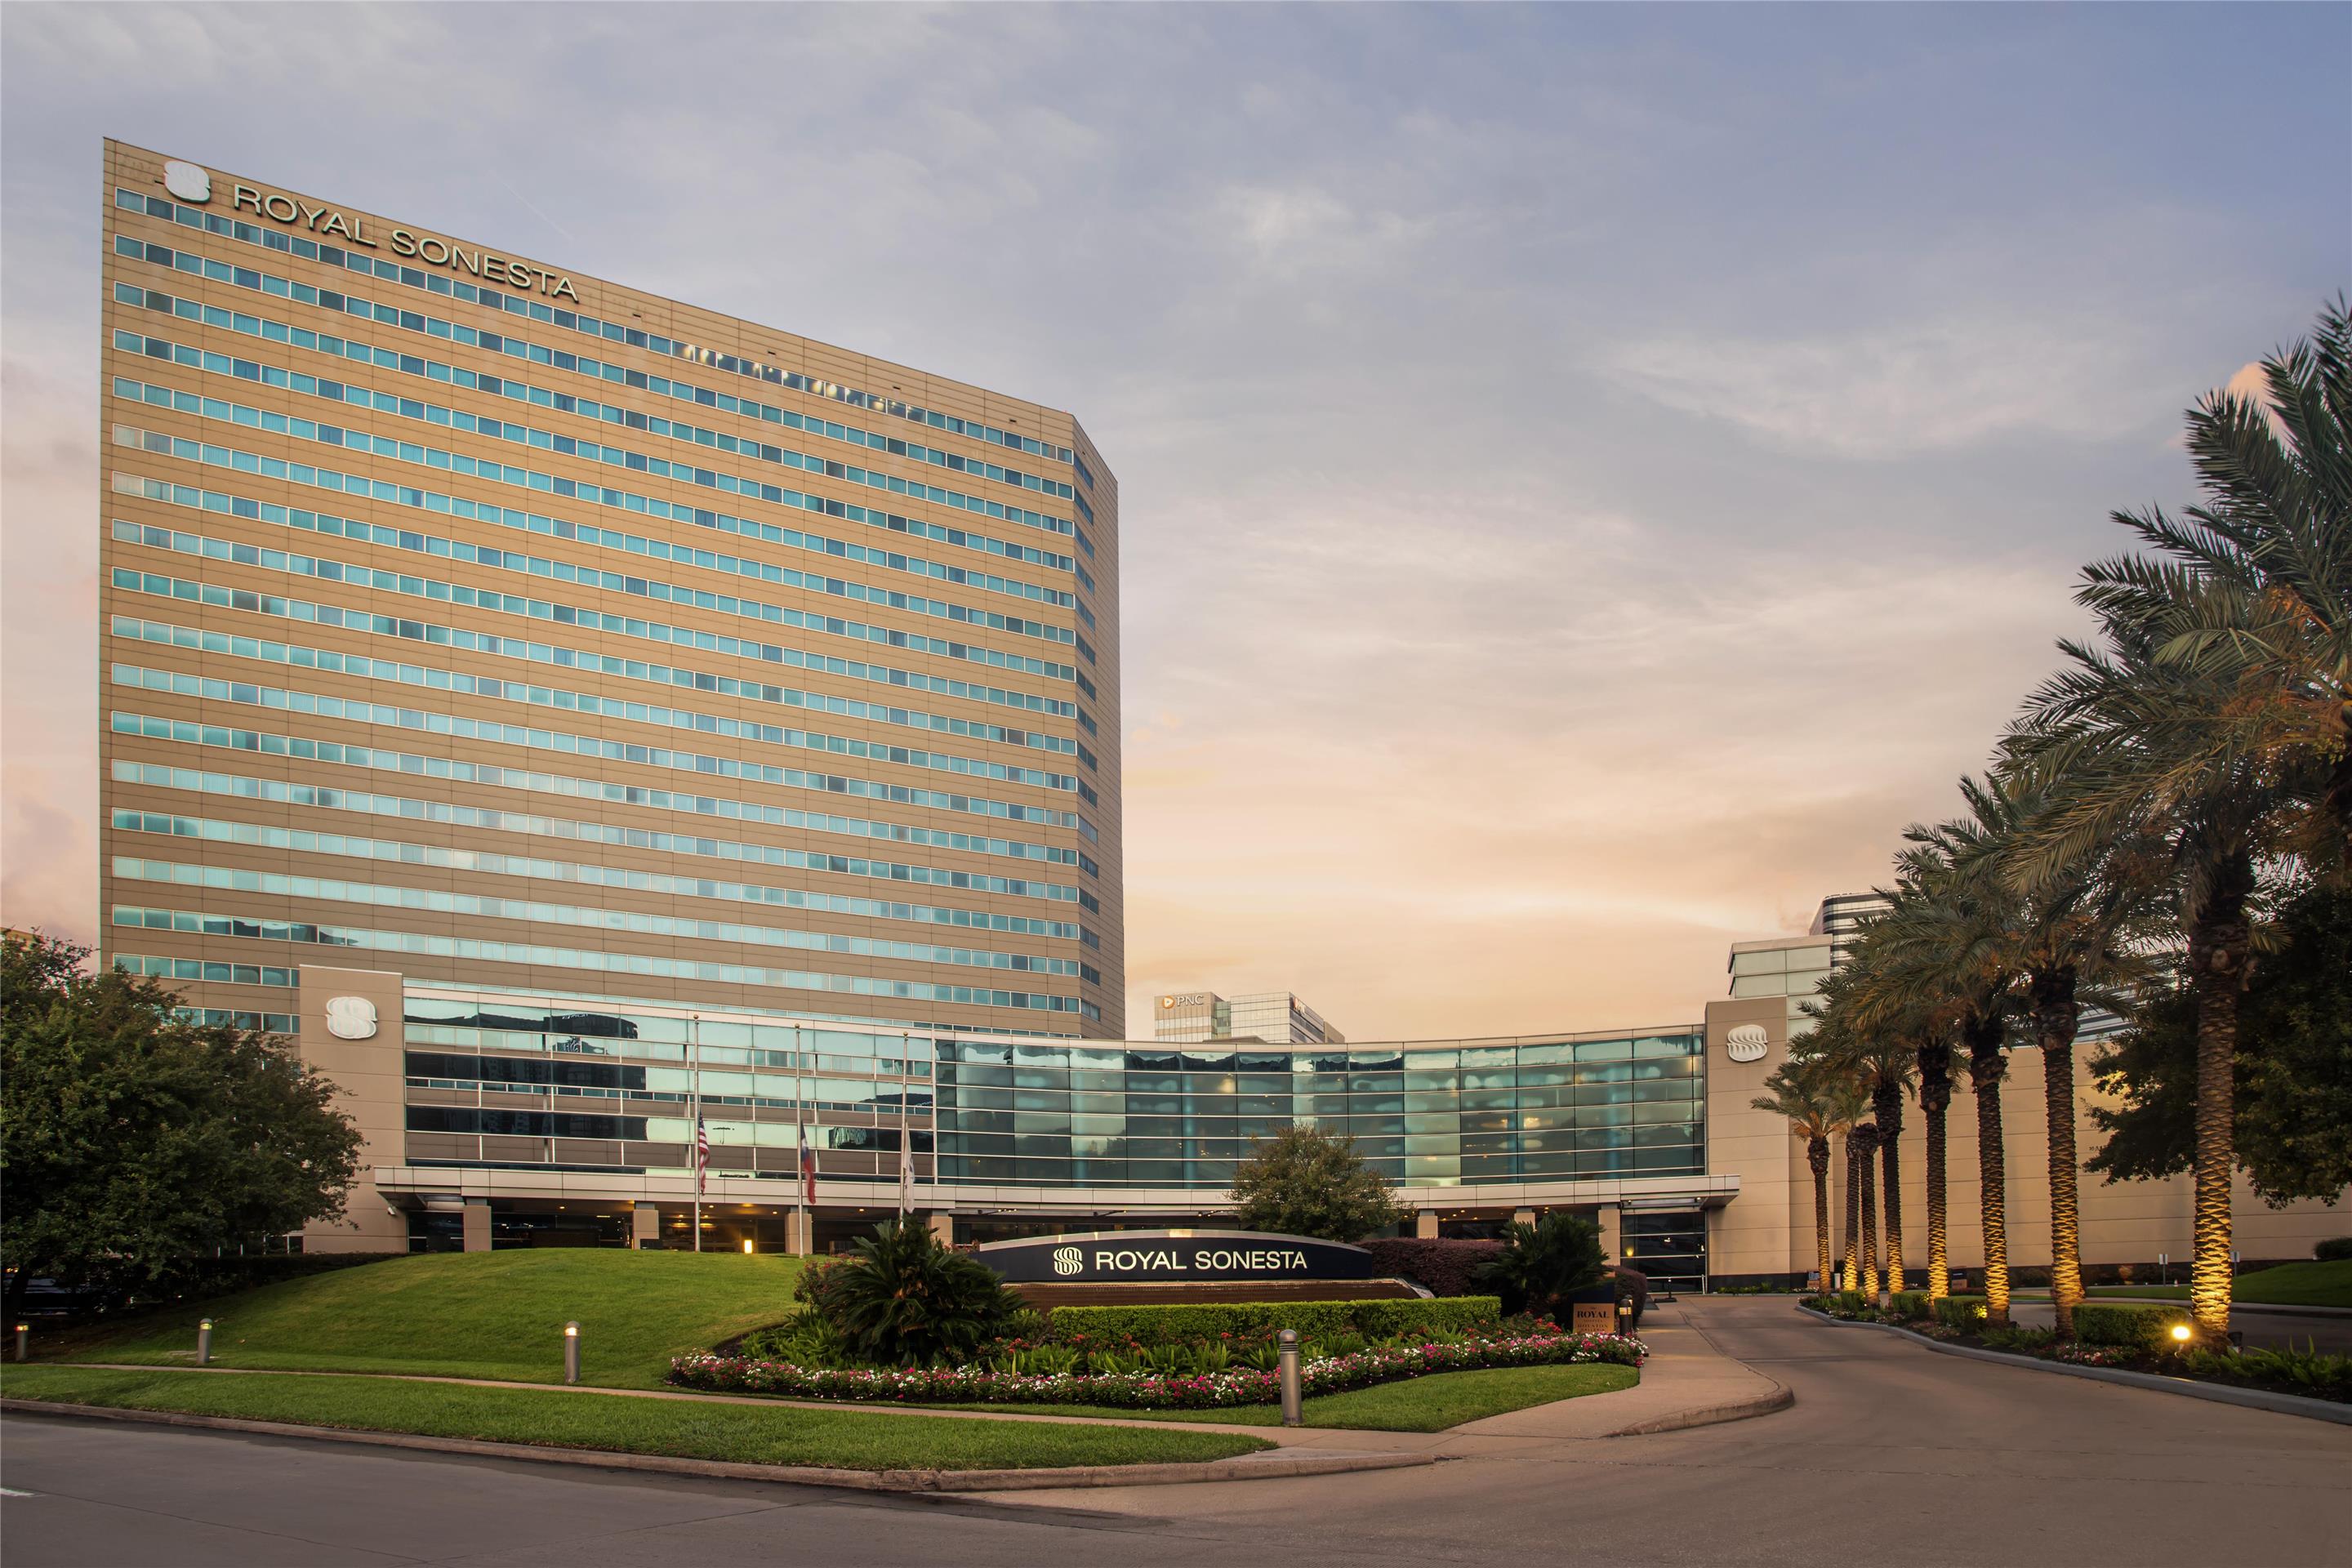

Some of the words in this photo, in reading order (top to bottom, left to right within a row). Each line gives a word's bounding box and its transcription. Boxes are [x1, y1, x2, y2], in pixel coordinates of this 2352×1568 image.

[234, 183, 376, 247] ROYAL
[391, 229, 579, 303] SONESTA
[1177, 995, 1203, 1006] PNC
[1096, 1250, 1187, 1271] ROYAL
[1195, 1250, 1307, 1270] SONESTA
